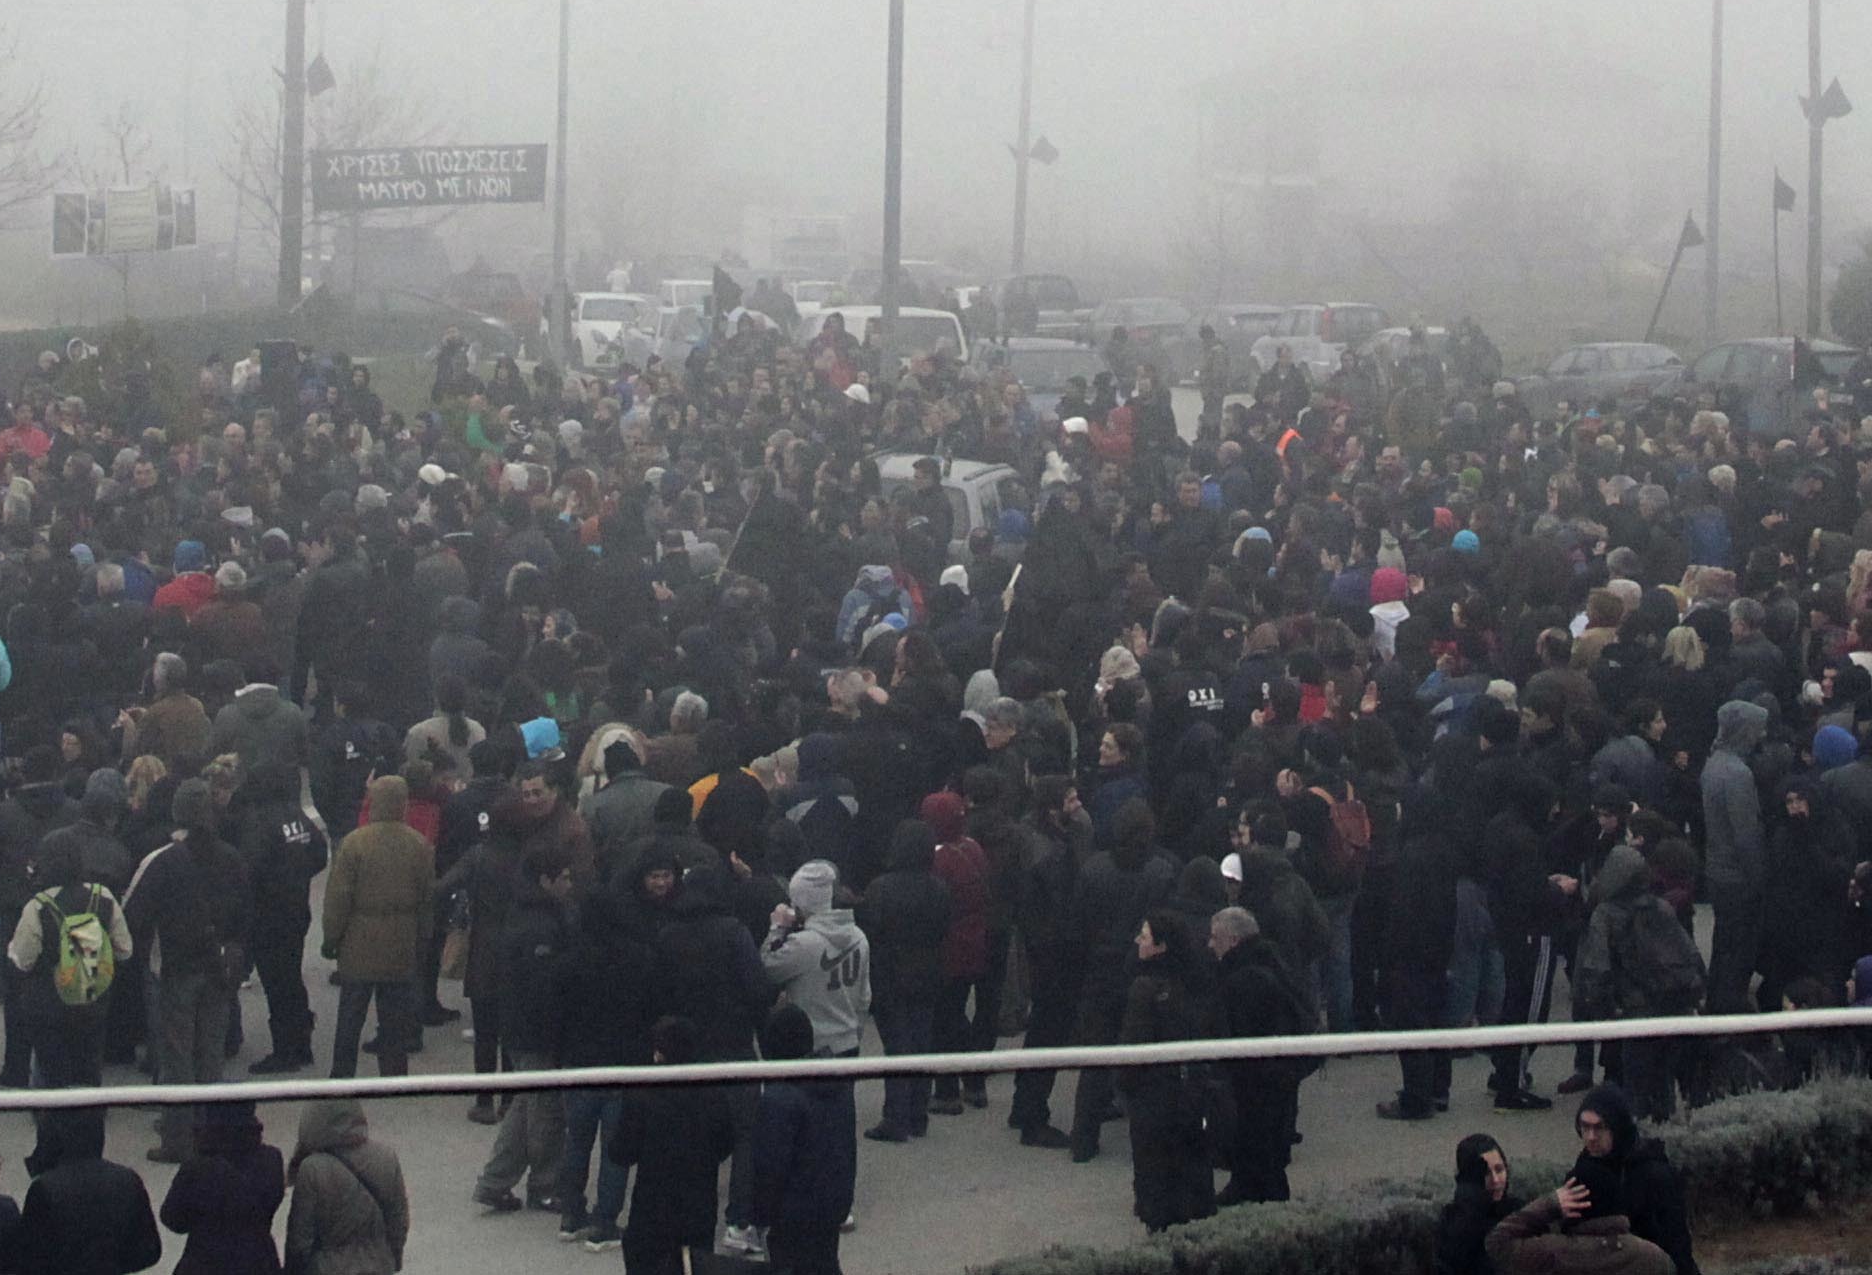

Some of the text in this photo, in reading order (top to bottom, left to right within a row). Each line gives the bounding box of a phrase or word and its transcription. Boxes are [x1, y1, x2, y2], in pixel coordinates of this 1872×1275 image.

[327, 149, 527, 178] ΧΡΥΣΕΣ ΥΠΟΣΧΕΣΕΙΣ
[358, 177, 512, 201] ΜΑΥΡΟ ΜΕΛΛΟΝ
